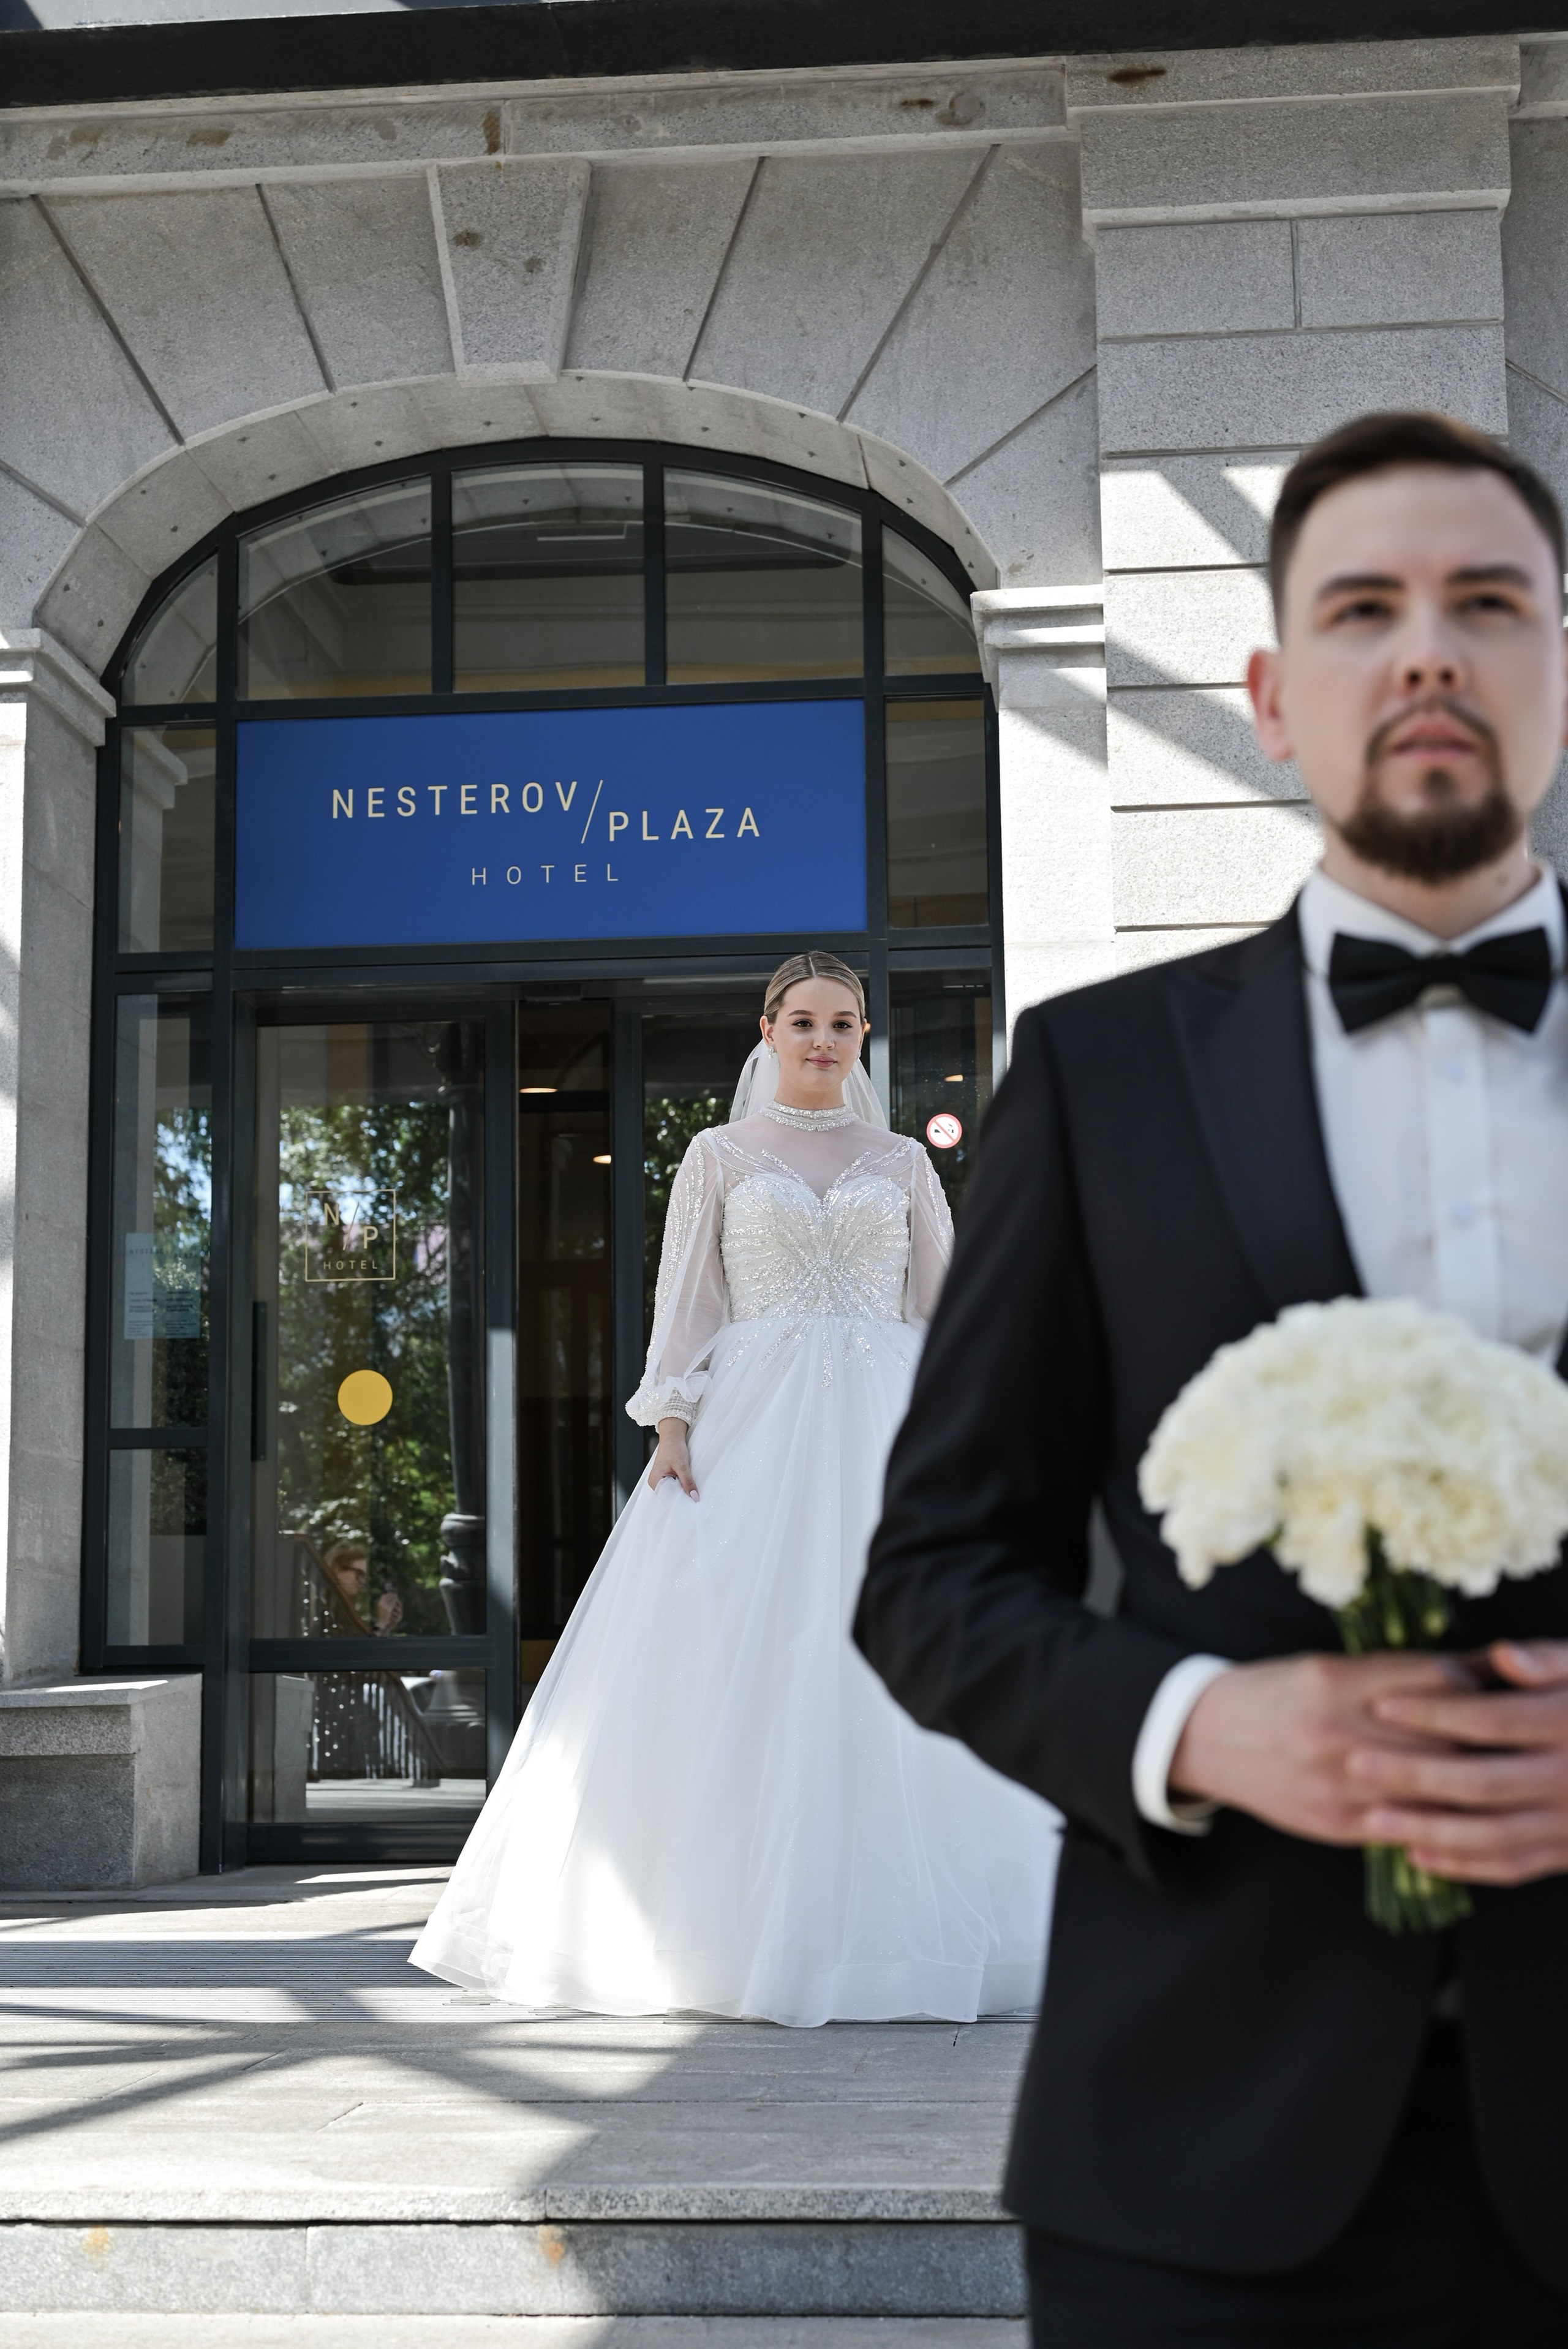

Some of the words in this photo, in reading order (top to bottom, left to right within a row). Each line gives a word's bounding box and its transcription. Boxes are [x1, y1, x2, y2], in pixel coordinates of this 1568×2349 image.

[332, 780, 578, 820] NESTEROV
[609, 807, 760, 842] PLAZA
[471, 863, 619, 886] HOTEL
[323, 1259, 378, 1270] HOTEL
